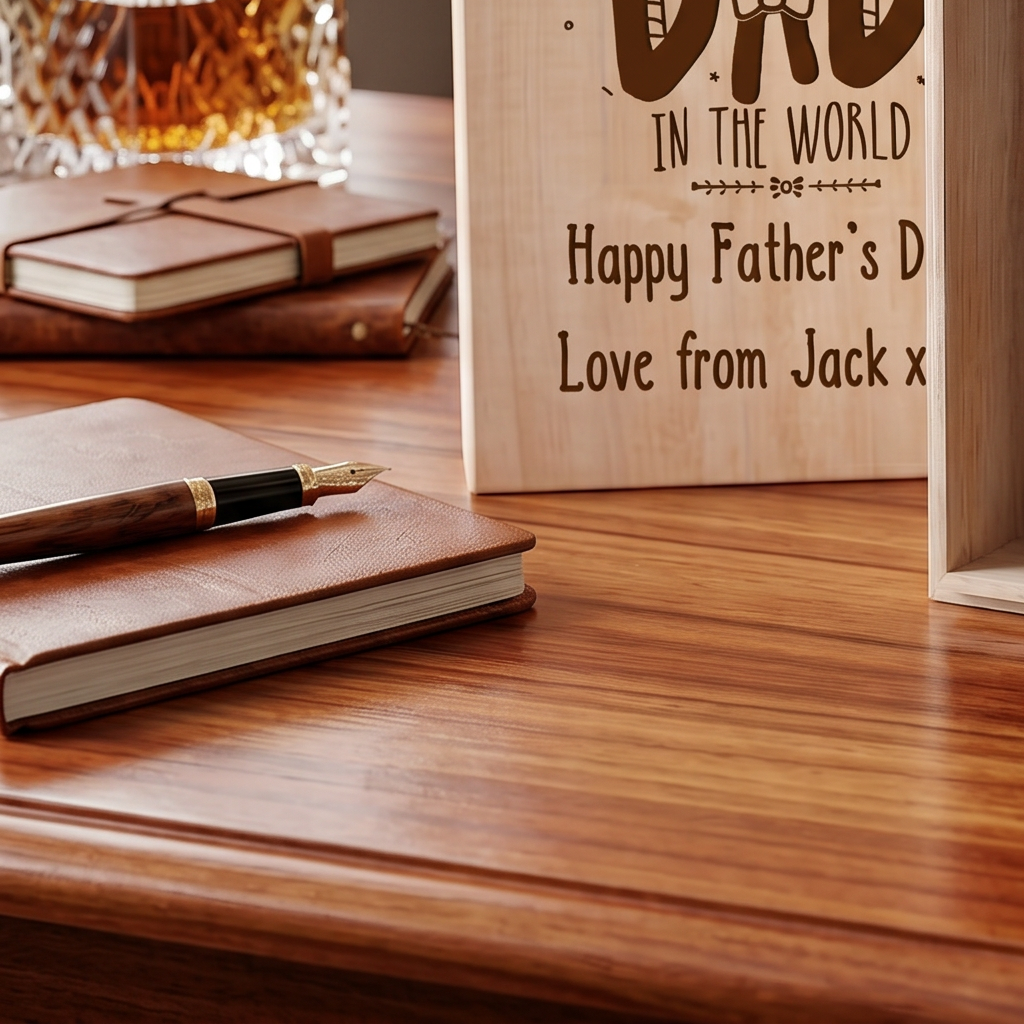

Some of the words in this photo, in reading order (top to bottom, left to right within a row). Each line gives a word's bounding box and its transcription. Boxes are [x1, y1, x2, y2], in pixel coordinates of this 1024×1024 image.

[652, 107, 689, 172] IN
[709, 106, 767, 169] THE
[787, 100, 911, 165] WORLD
[567, 223, 689, 303] Happy
[711, 221, 879, 284] Father's
[558, 330, 655, 392] Love
[676, 330, 768, 391] from
[790, 327, 889, 389] Jack
